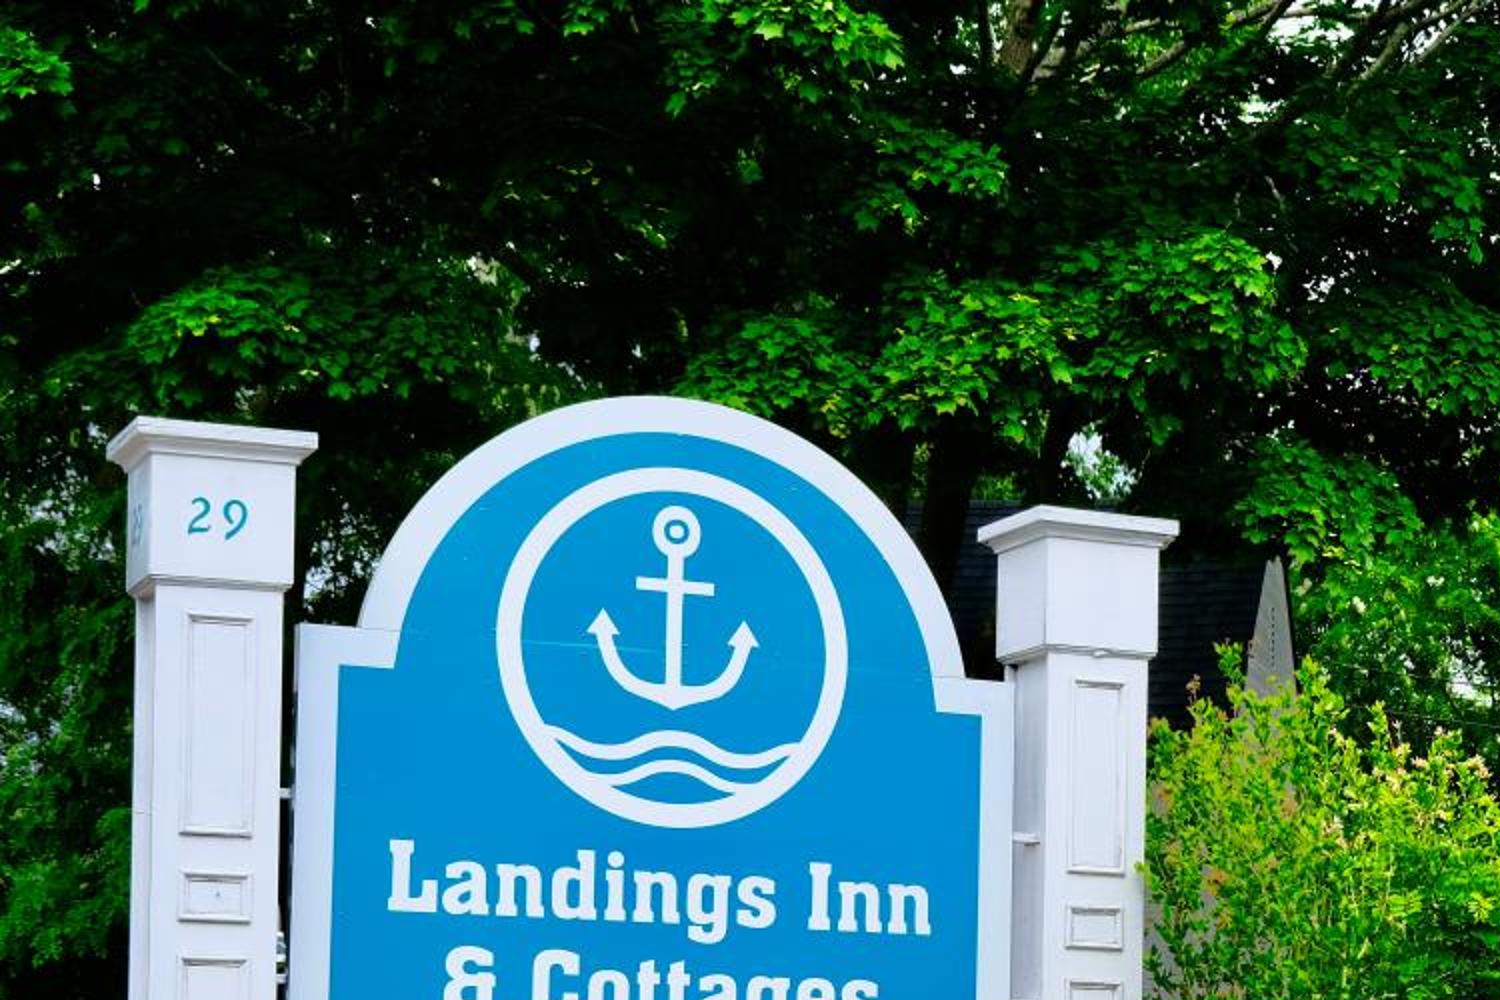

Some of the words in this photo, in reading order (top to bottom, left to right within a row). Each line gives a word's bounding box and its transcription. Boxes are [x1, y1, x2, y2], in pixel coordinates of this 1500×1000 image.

[188, 496, 248, 540] 29
[387, 839, 776, 944] Landings
[808, 862, 931, 935] Inn
